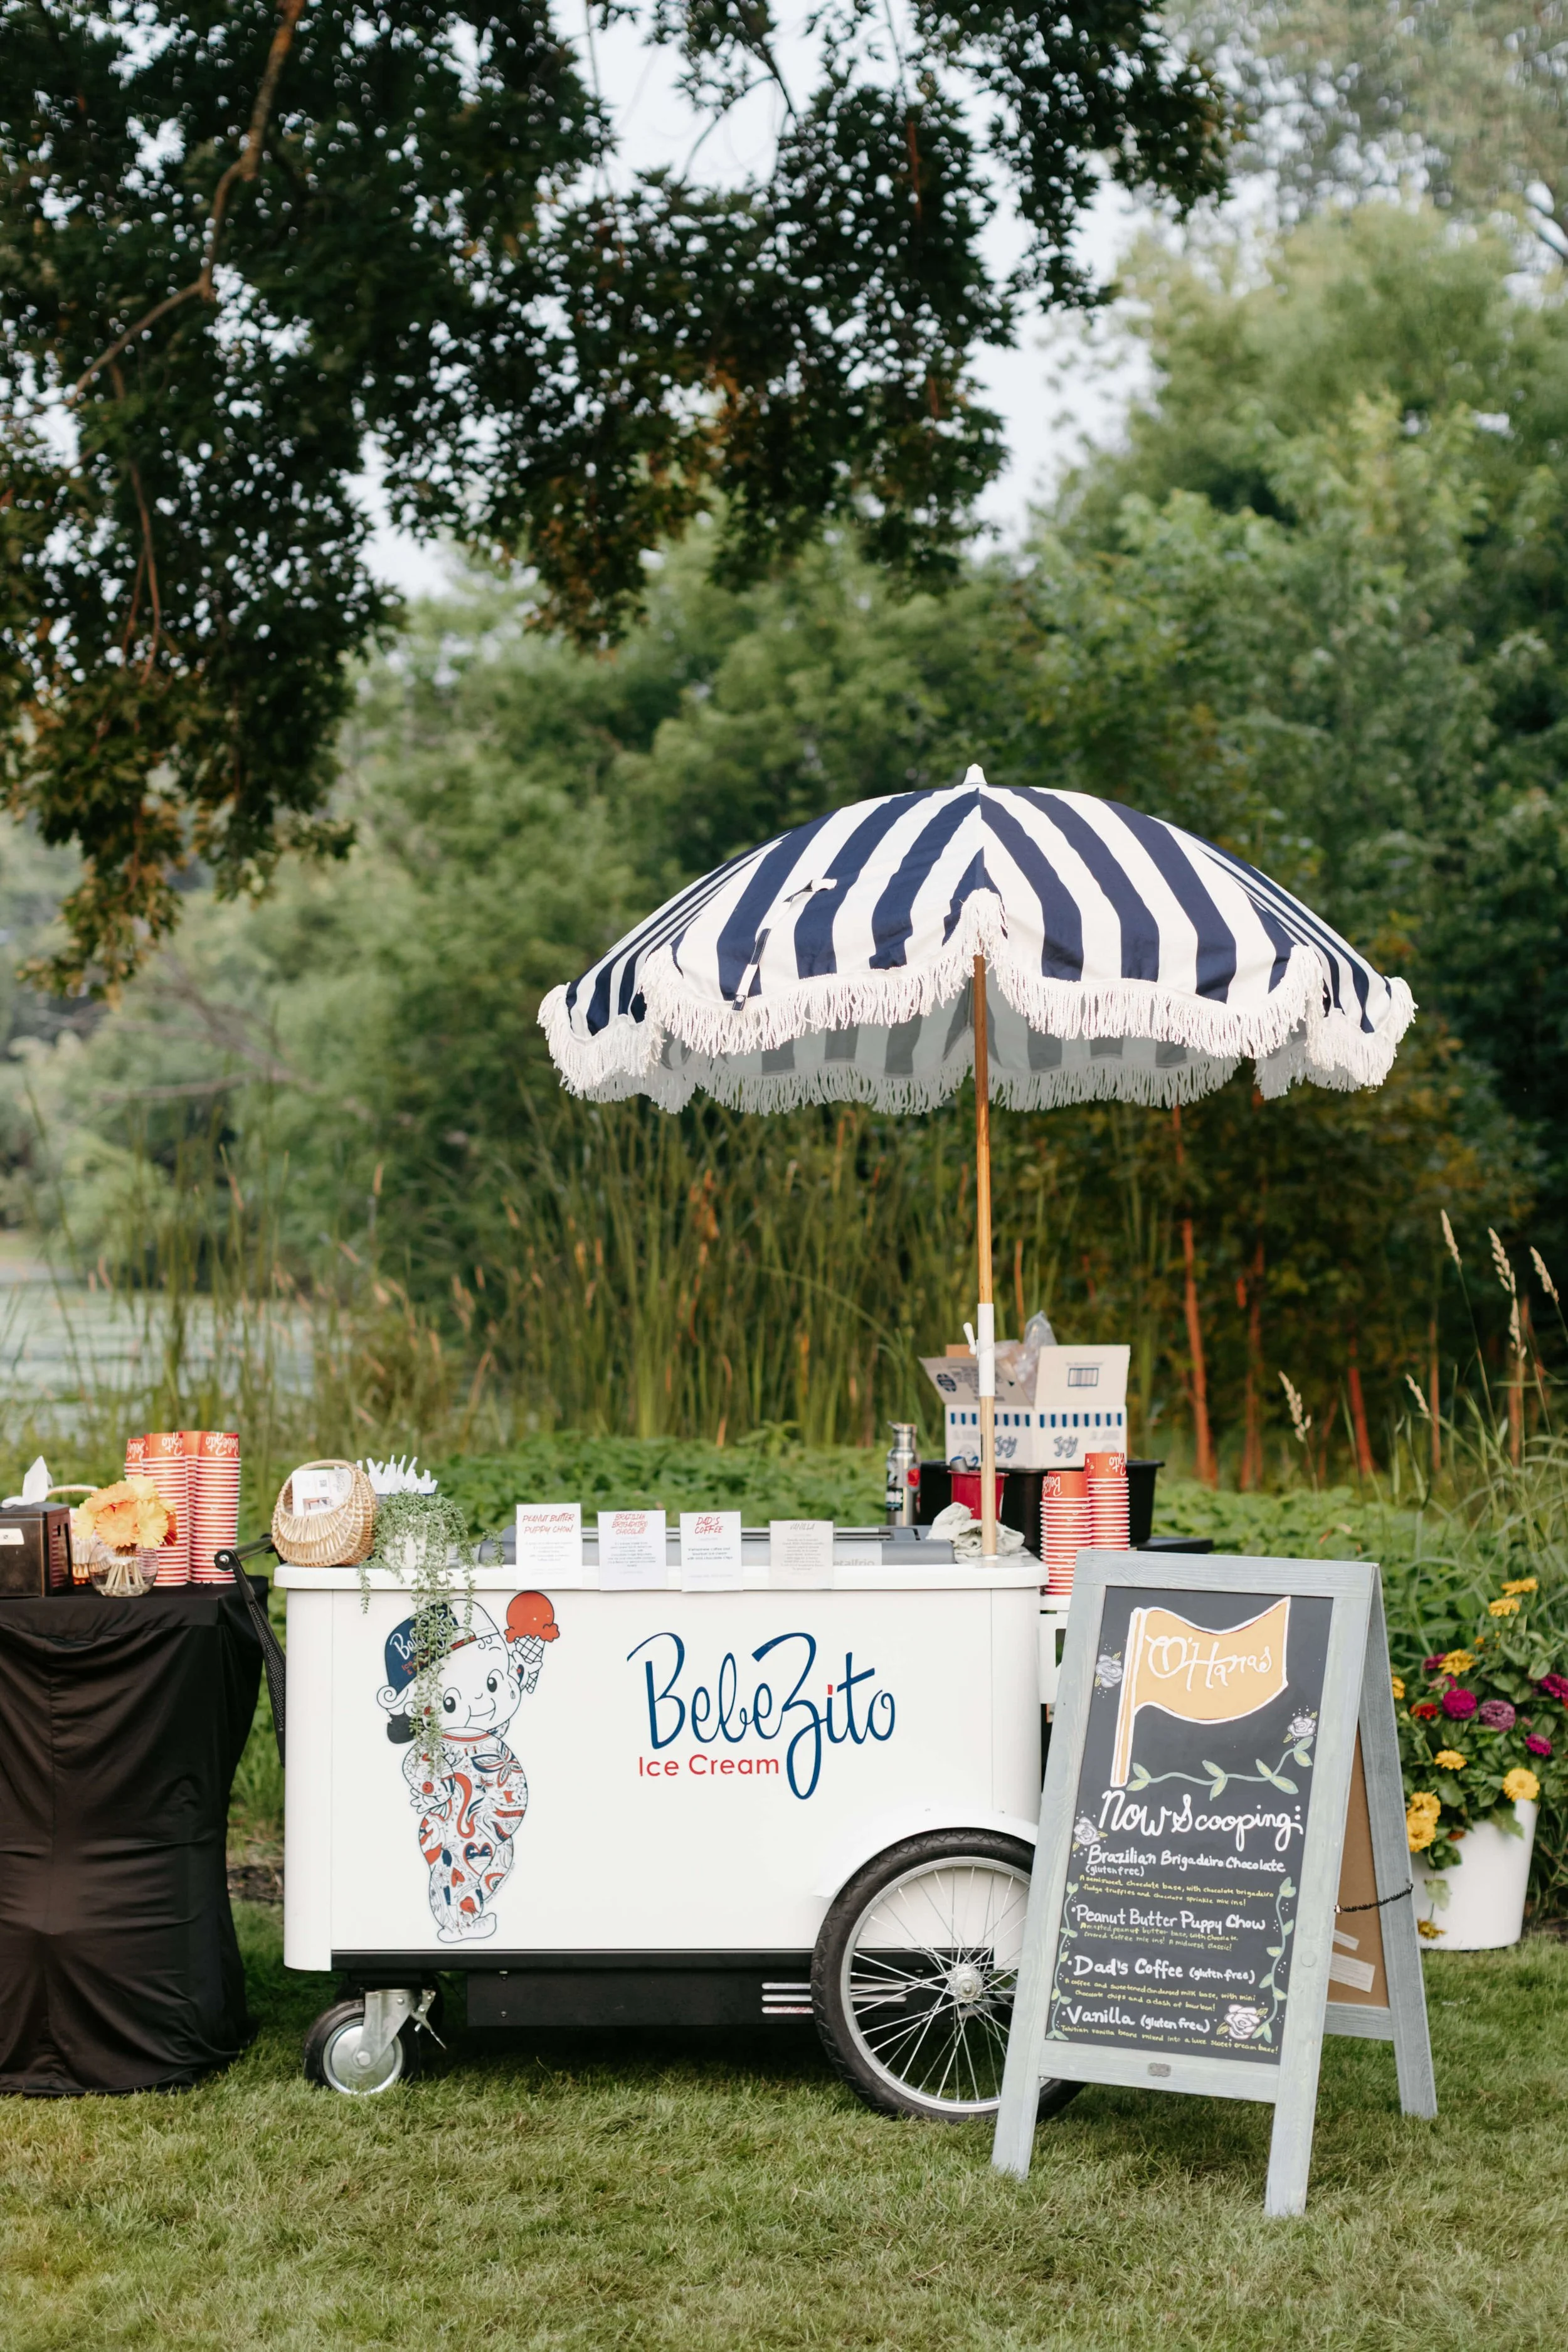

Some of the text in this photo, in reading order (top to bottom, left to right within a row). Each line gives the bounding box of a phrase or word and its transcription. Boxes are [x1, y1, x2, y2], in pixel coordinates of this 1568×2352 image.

[522, 1512, 575, 1522] PEANUT BUTTER
[696, 1516, 721, 1525] DAD'S
[524, 1525, 551, 1535] PUPPY
[694, 1525, 724, 1534] COFFEE
[833, 1558, 875, 1566] etalfrio
[638, 1754, 780, 1777] Ice Cream
[1099, 1790, 1304, 1851] Now Scooping:
[1087, 1844, 1286, 1872] Brazilian Brigadeiro Chocolate
[1162, 1882, 1184, 1892] base,
[1236, 1888, 1274, 1898] brigadeiro
[1076, 1904, 1266, 1935] Peanut Butter Puppy Chow
[1110, 1932, 1133, 1941] toffee
[1073, 1955, 1129, 1976] Dad's
[1135, 1957, 1183, 1979] Coffee
[1153, 1998, 1171, 2007] dash
[1066, 2005, 1135, 2025] Vanilla
